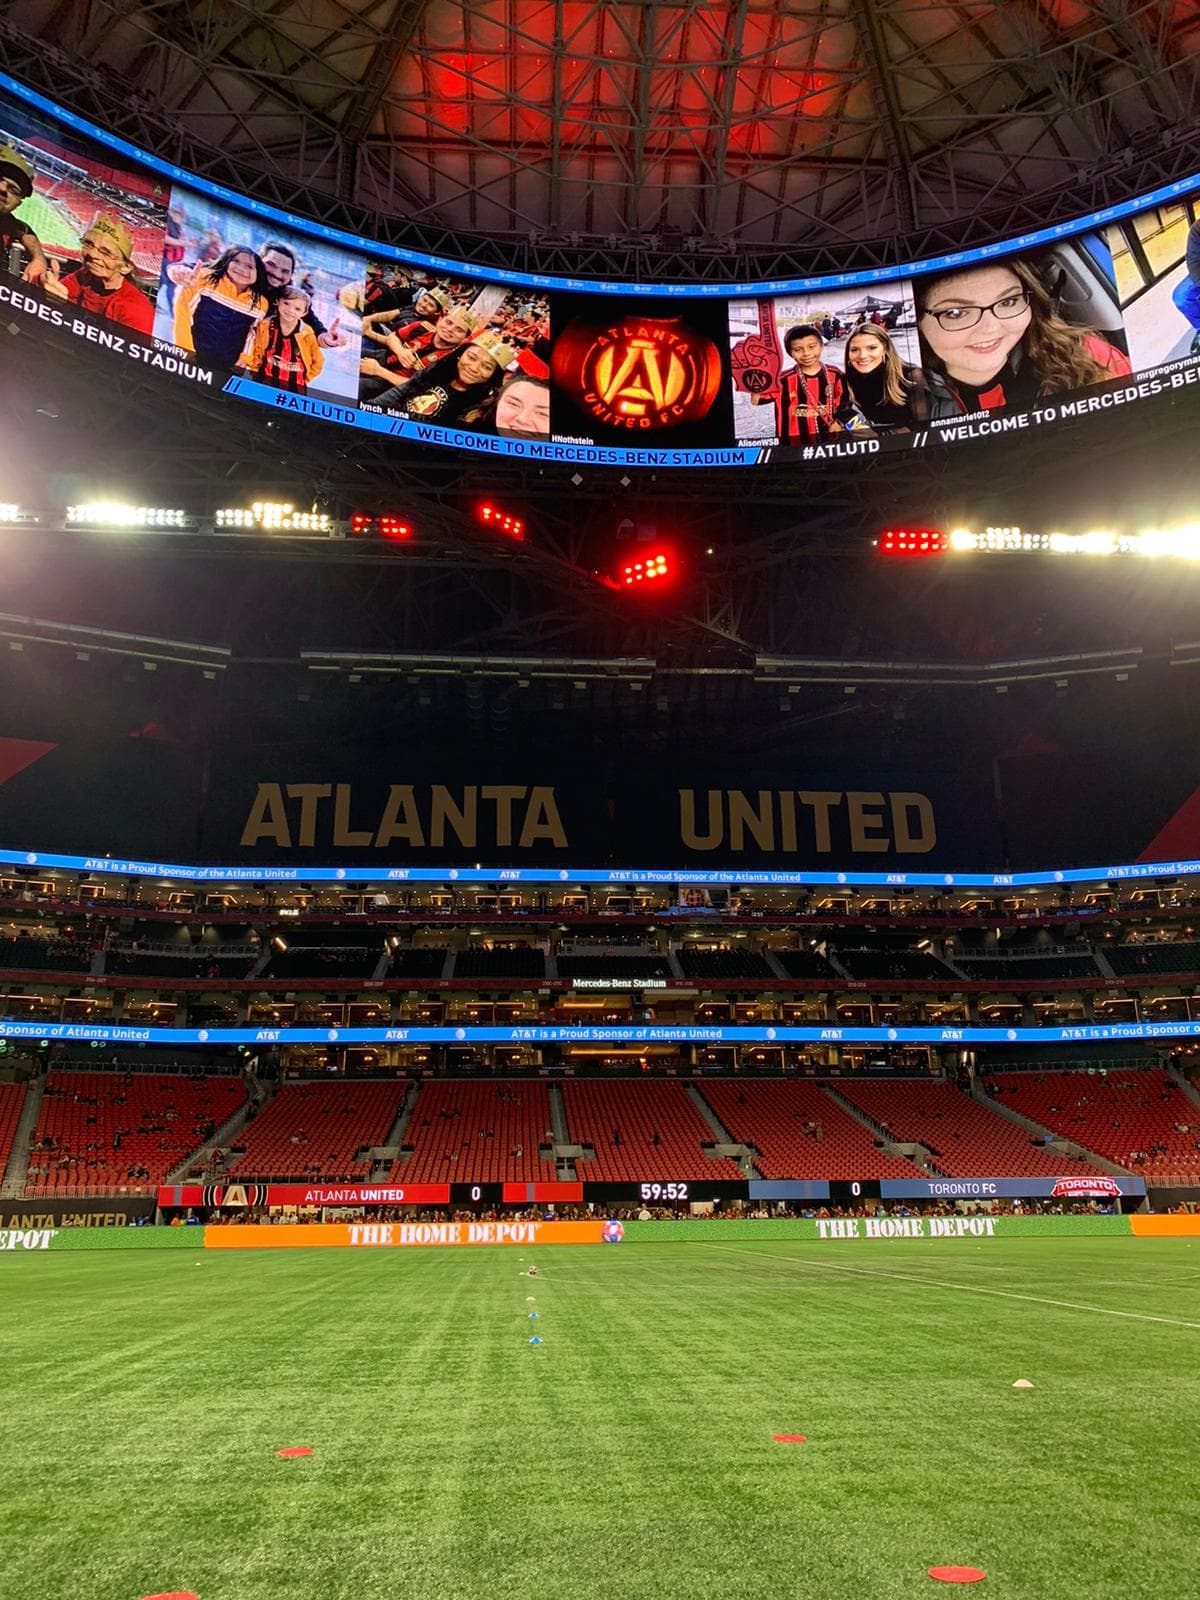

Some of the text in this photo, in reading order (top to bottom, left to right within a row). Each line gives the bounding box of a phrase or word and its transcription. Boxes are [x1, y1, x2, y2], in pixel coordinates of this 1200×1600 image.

[0, 285, 213, 385] CEDES-BENZ STADIUM
[597, 327, 689, 355] ATLANTA
[275, 393, 356, 424] #ATLUTD
[584, 393, 684, 428] UNITED FC
[940, 367, 1200, 442] WELCOME TO MERCEDES-BE
[417, 426, 745, 465] WELCOME TO MERCEDES-BENZ STADIUM
[803, 439, 880, 460] #ATLUTD
[240, 783, 936, 853] ATLANTA UNITED
[84, 859, 296, 879] AT&T is a Proud Sponsor of the Atlanta United
[388, 870, 410, 878] AT&T
[500, 871, 521, 880] AT&T
[1107, 868, 1129, 877] AT&T
[1132, 867, 1140, 876] is
[1149, 863, 1175, 874] Proud
[609, 871, 630, 880] AT&T
[632, 872, 640, 880] is
[648, 872, 672, 880] Proud
[674, 871, 707, 883] Sponsor
[709, 871, 719, 880] of
[719, 872, 734, 881] the
[736, 872, 769, 881] Atlanta
[771, 873, 801, 882] United
[887, 875, 907, 884] AT&T
[572, 979, 632, 988] Mercedes-Benz
[633, 979, 667, 988] Stadium
[0, 1024, 149, 1039] Sponsor of Atlanta United
[256, 1031, 281, 1040] AT&T
[385, 1030, 409, 1040] AT&T
[511, 1029, 537, 1038] AT&T
[540, 1029, 548, 1038] is
[560, 1029, 589, 1038] Proud
[592, 1029, 633, 1040] Sponsor
[636, 1029, 648, 1038] of
[650, 1029, 686, 1038] Atlanta
[689, 1029, 722, 1039] United
[821, 1030, 843, 1039] AT&T
[942, 1030, 963, 1039] AT&T
[1061, 1029, 1087, 1039] AT&T
[1090, 1028, 1099, 1038] is
[1102, 1029, 1109, 1037] a
[1111, 1027, 1143, 1036] Proud
[1147, 1025, 1191, 1037] Sponsor
[641, 1183, 688, 1200] 59:52
[851, 1182, 861, 1196] 0
[928, 1183, 997, 1194] TORONTO FC
[1059, 1179, 1113, 1191] TORONTO
[305, 1189, 404, 1201] ATLANTA UNITED
[471, 1186, 481, 1200] 0
[348, 1222, 539, 1244] THE HOME DEPOT
[816, 1217, 996, 1238] THE HOME DEPOT
